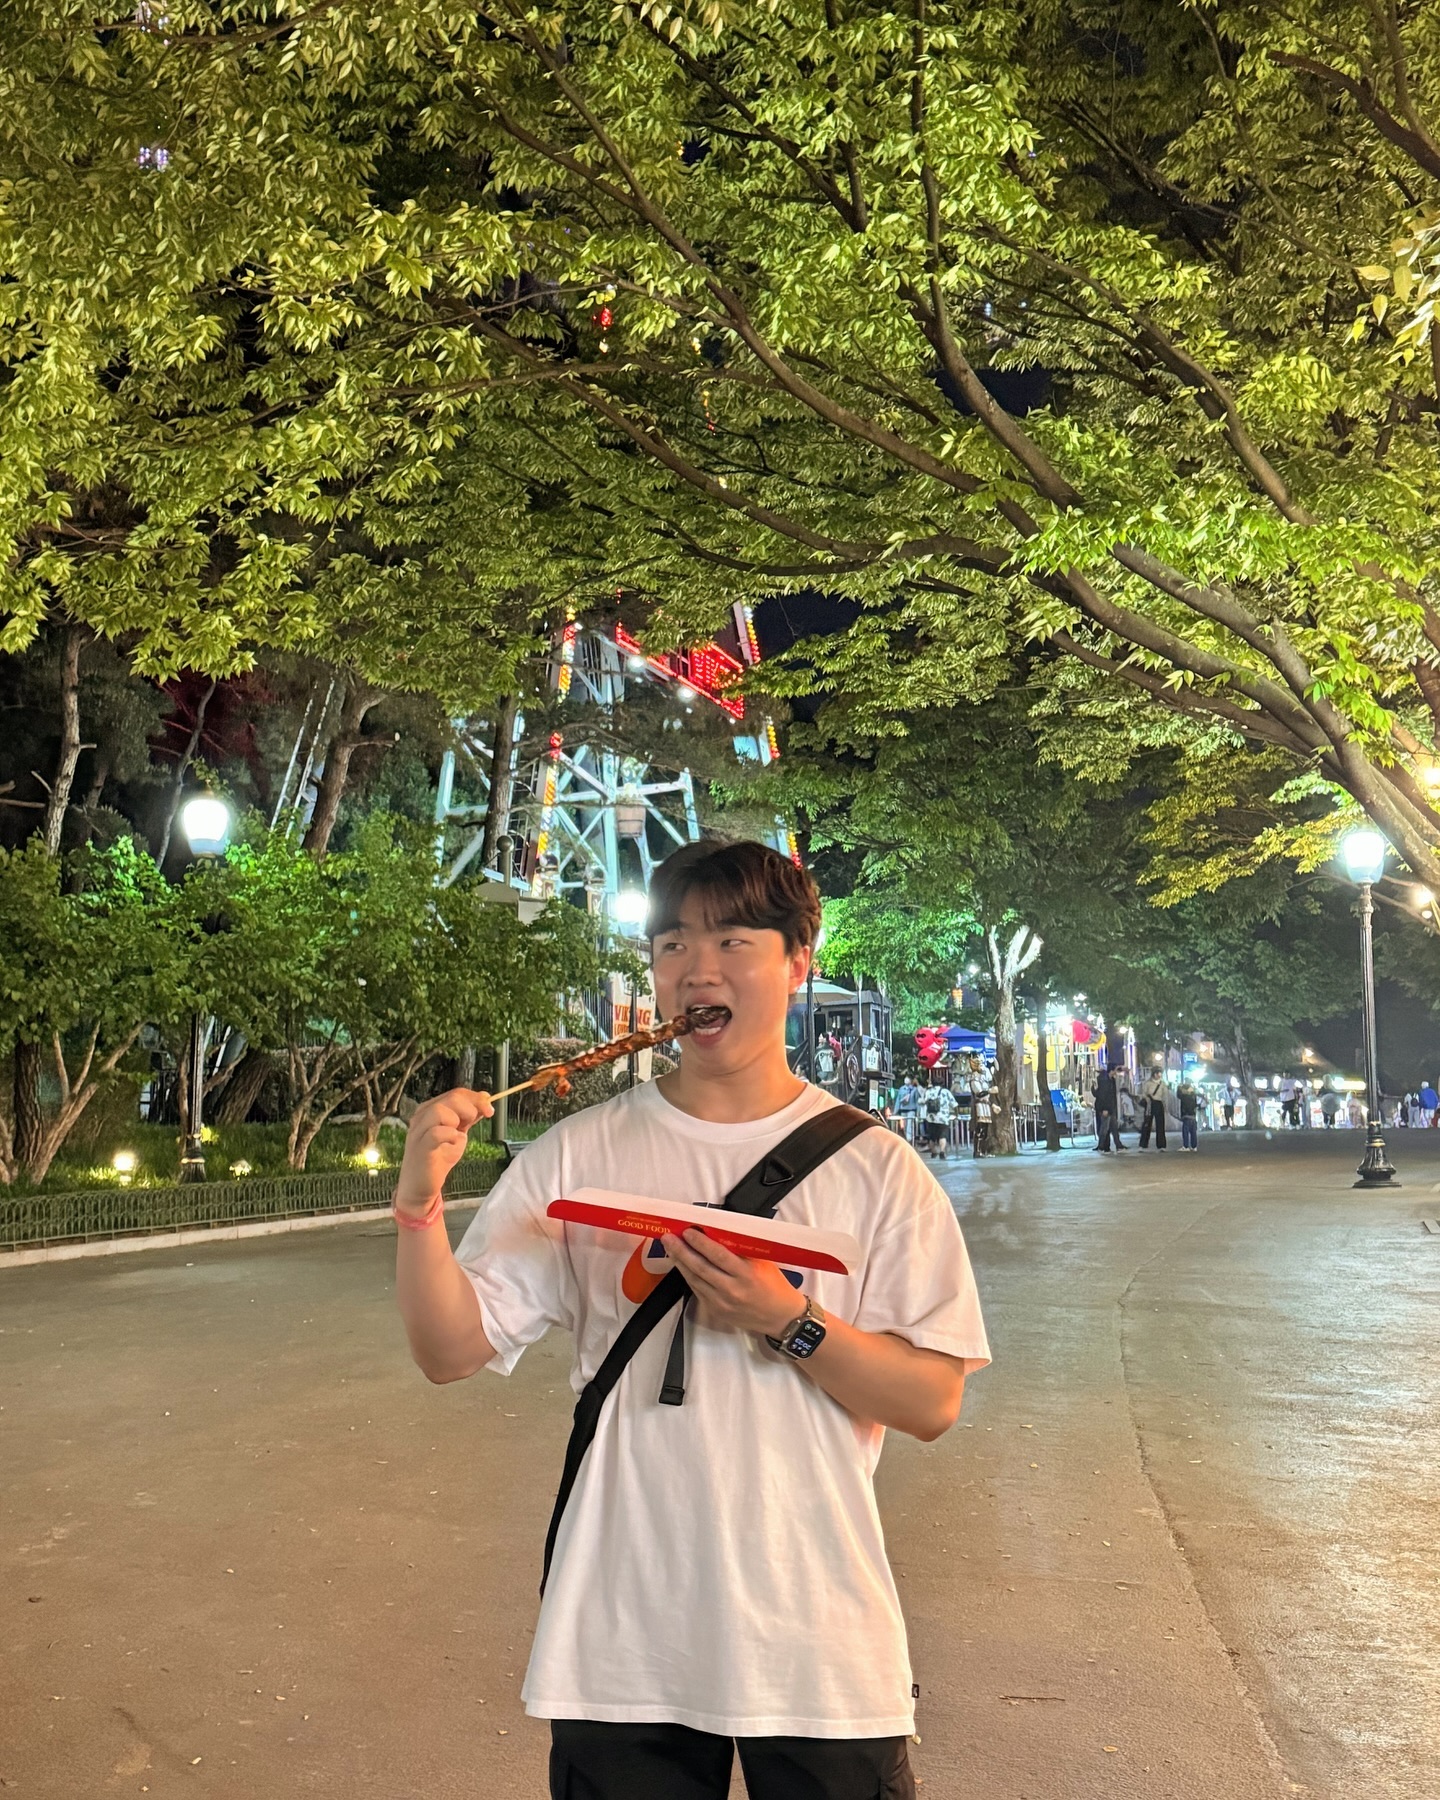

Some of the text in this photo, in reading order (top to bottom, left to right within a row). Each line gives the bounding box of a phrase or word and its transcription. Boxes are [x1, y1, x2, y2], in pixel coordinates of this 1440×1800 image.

[614, 1004, 651, 1026] VIKNG
[617, 1219, 644, 1230] GOOD
[645, 1224, 671, 1233] FOOD
